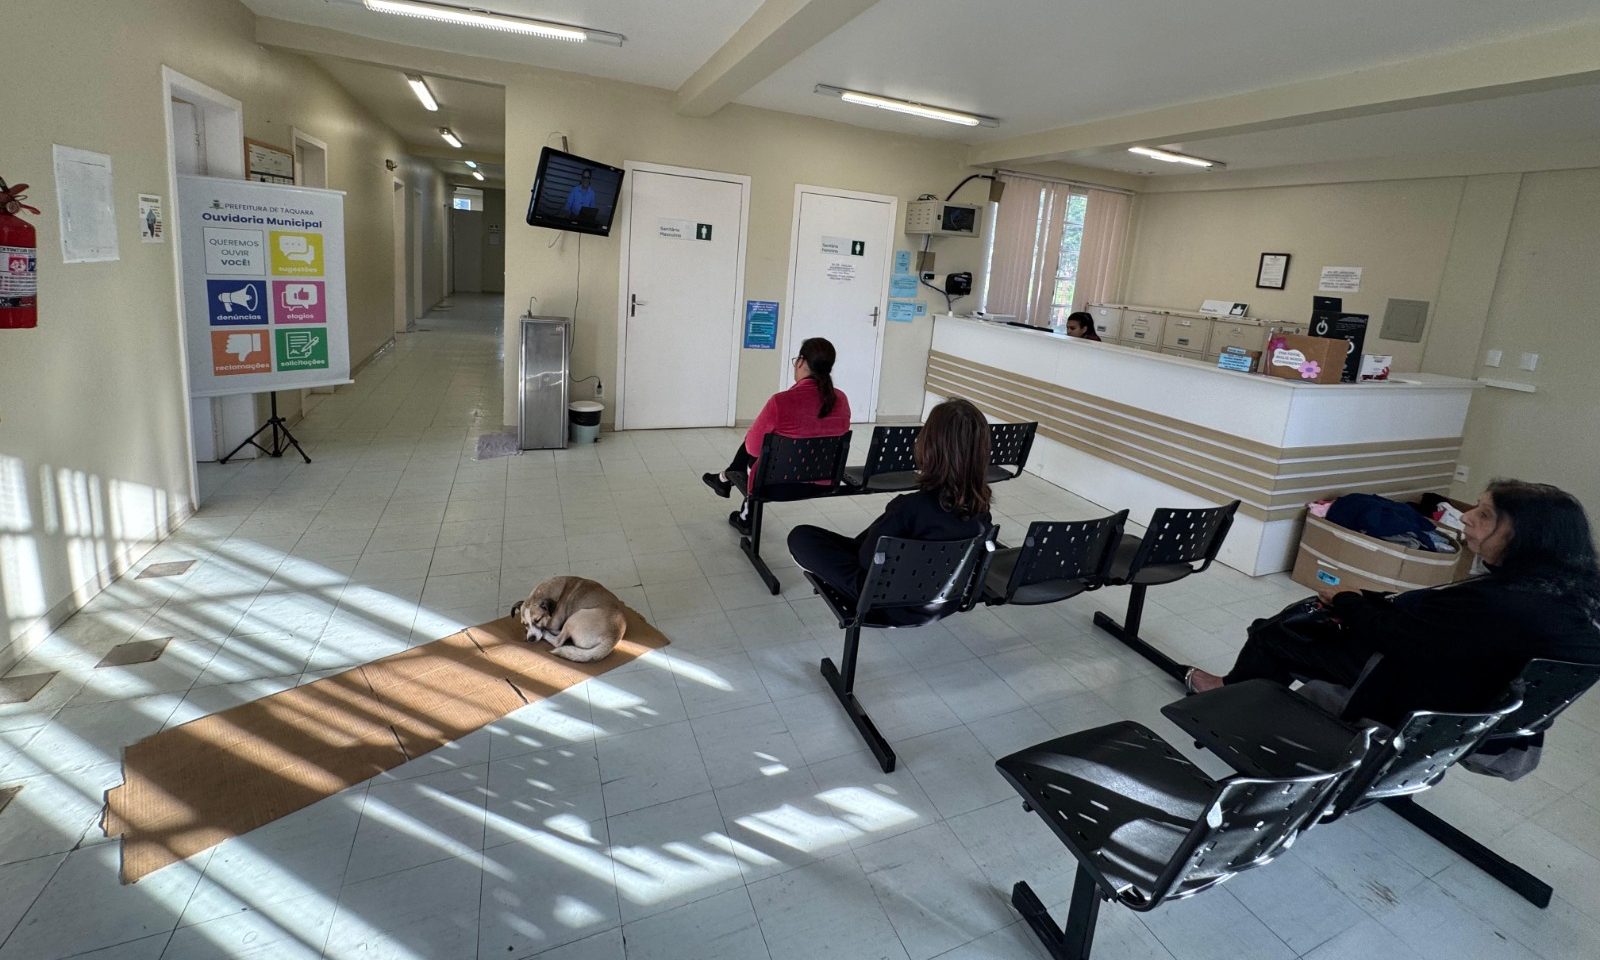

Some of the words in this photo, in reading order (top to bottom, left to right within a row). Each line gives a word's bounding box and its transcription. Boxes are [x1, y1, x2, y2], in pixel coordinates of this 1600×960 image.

[224, 203, 267, 213] PREFEITURA
[280, 207, 314, 216] TAQUARA
[202, 212, 264, 224] Ouvidoria
[266, 217, 322, 229] Municipal
[209, 239, 259, 247] QUEREMOS
[221, 258, 250, 266] VOCÊ!
[215, 362, 270, 371] reclamações
[281, 359, 325, 367] solicitações
